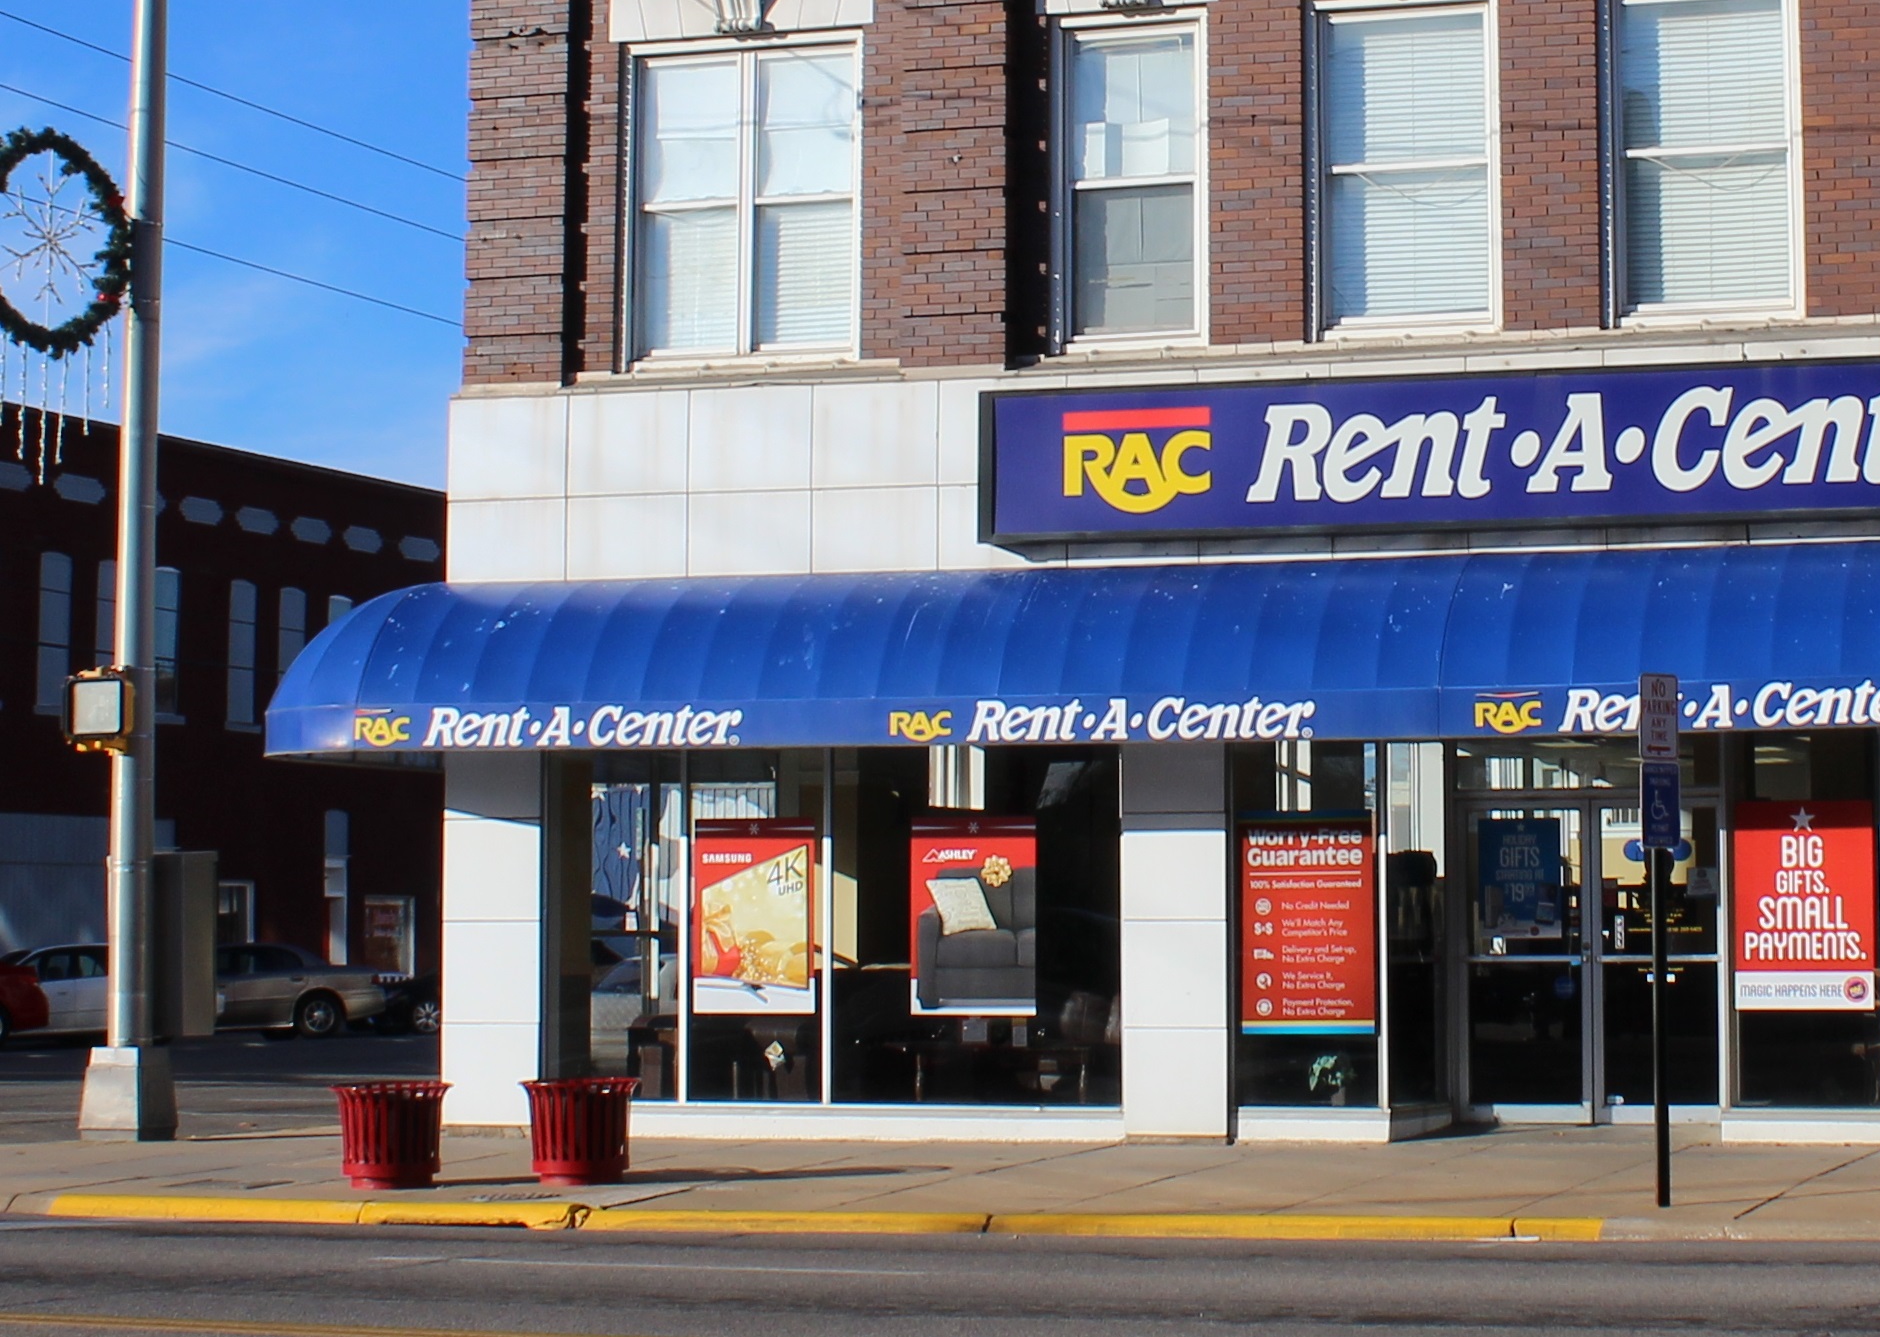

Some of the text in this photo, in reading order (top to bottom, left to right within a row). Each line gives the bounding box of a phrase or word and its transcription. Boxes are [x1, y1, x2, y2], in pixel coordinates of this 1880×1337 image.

[1063, 430, 1212, 513] RAC
[1651, 682, 1666, 697] NO
[1642, 699, 1676, 715] PARKING
[1475, 700, 1542, 733] RAC
[1651, 717, 1666, 728] ANY
[354, 717, 412, 746] RAC
[889, 710, 953, 741] RAC
[1651, 730, 1668, 741] TIME
[1248, 829, 1362, 848] Worry-Free
[701, 852, 752, 864] SAMSUNG
[937, 848, 976, 861] ASHLEY
[1247, 847, 1363, 866] Guarantee
[1499, 846, 1541, 868] GIFTS
[1781, 835, 1824, 868] BIG
[767, 849, 804, 885] 4K
[778, 881, 804, 896] UHD
[1250, 878, 1362, 890] 100% Satisfaction Guaranteed
[1776, 870, 1830, 894] GIFTS.
[1281, 900, 1350, 910] No Credit Needed
[1758, 895, 1849, 930] SMALL
[1328, 918, 1343, 928] Any
[1281, 944, 1312, 955] Delivery
[1314, 944, 1329, 953] and
[1744, 931, 1867, 961] PAYMENTS.
[1281, 954, 1345, 965] No Extra Charge
[1281, 971, 1296, 980] We
[1297, 971, 1325, 980] Service
[1282, 980, 1345, 991] No Extra Charge
[1740, 983, 1772, 998] MAGIC
[1774, 983, 1817, 998] HAPPENS
[1820, 983, 1843, 998] HERE
[1282, 997, 1314, 1007] Payment
[1282, 1007, 1345, 1018] No Extra Charge
